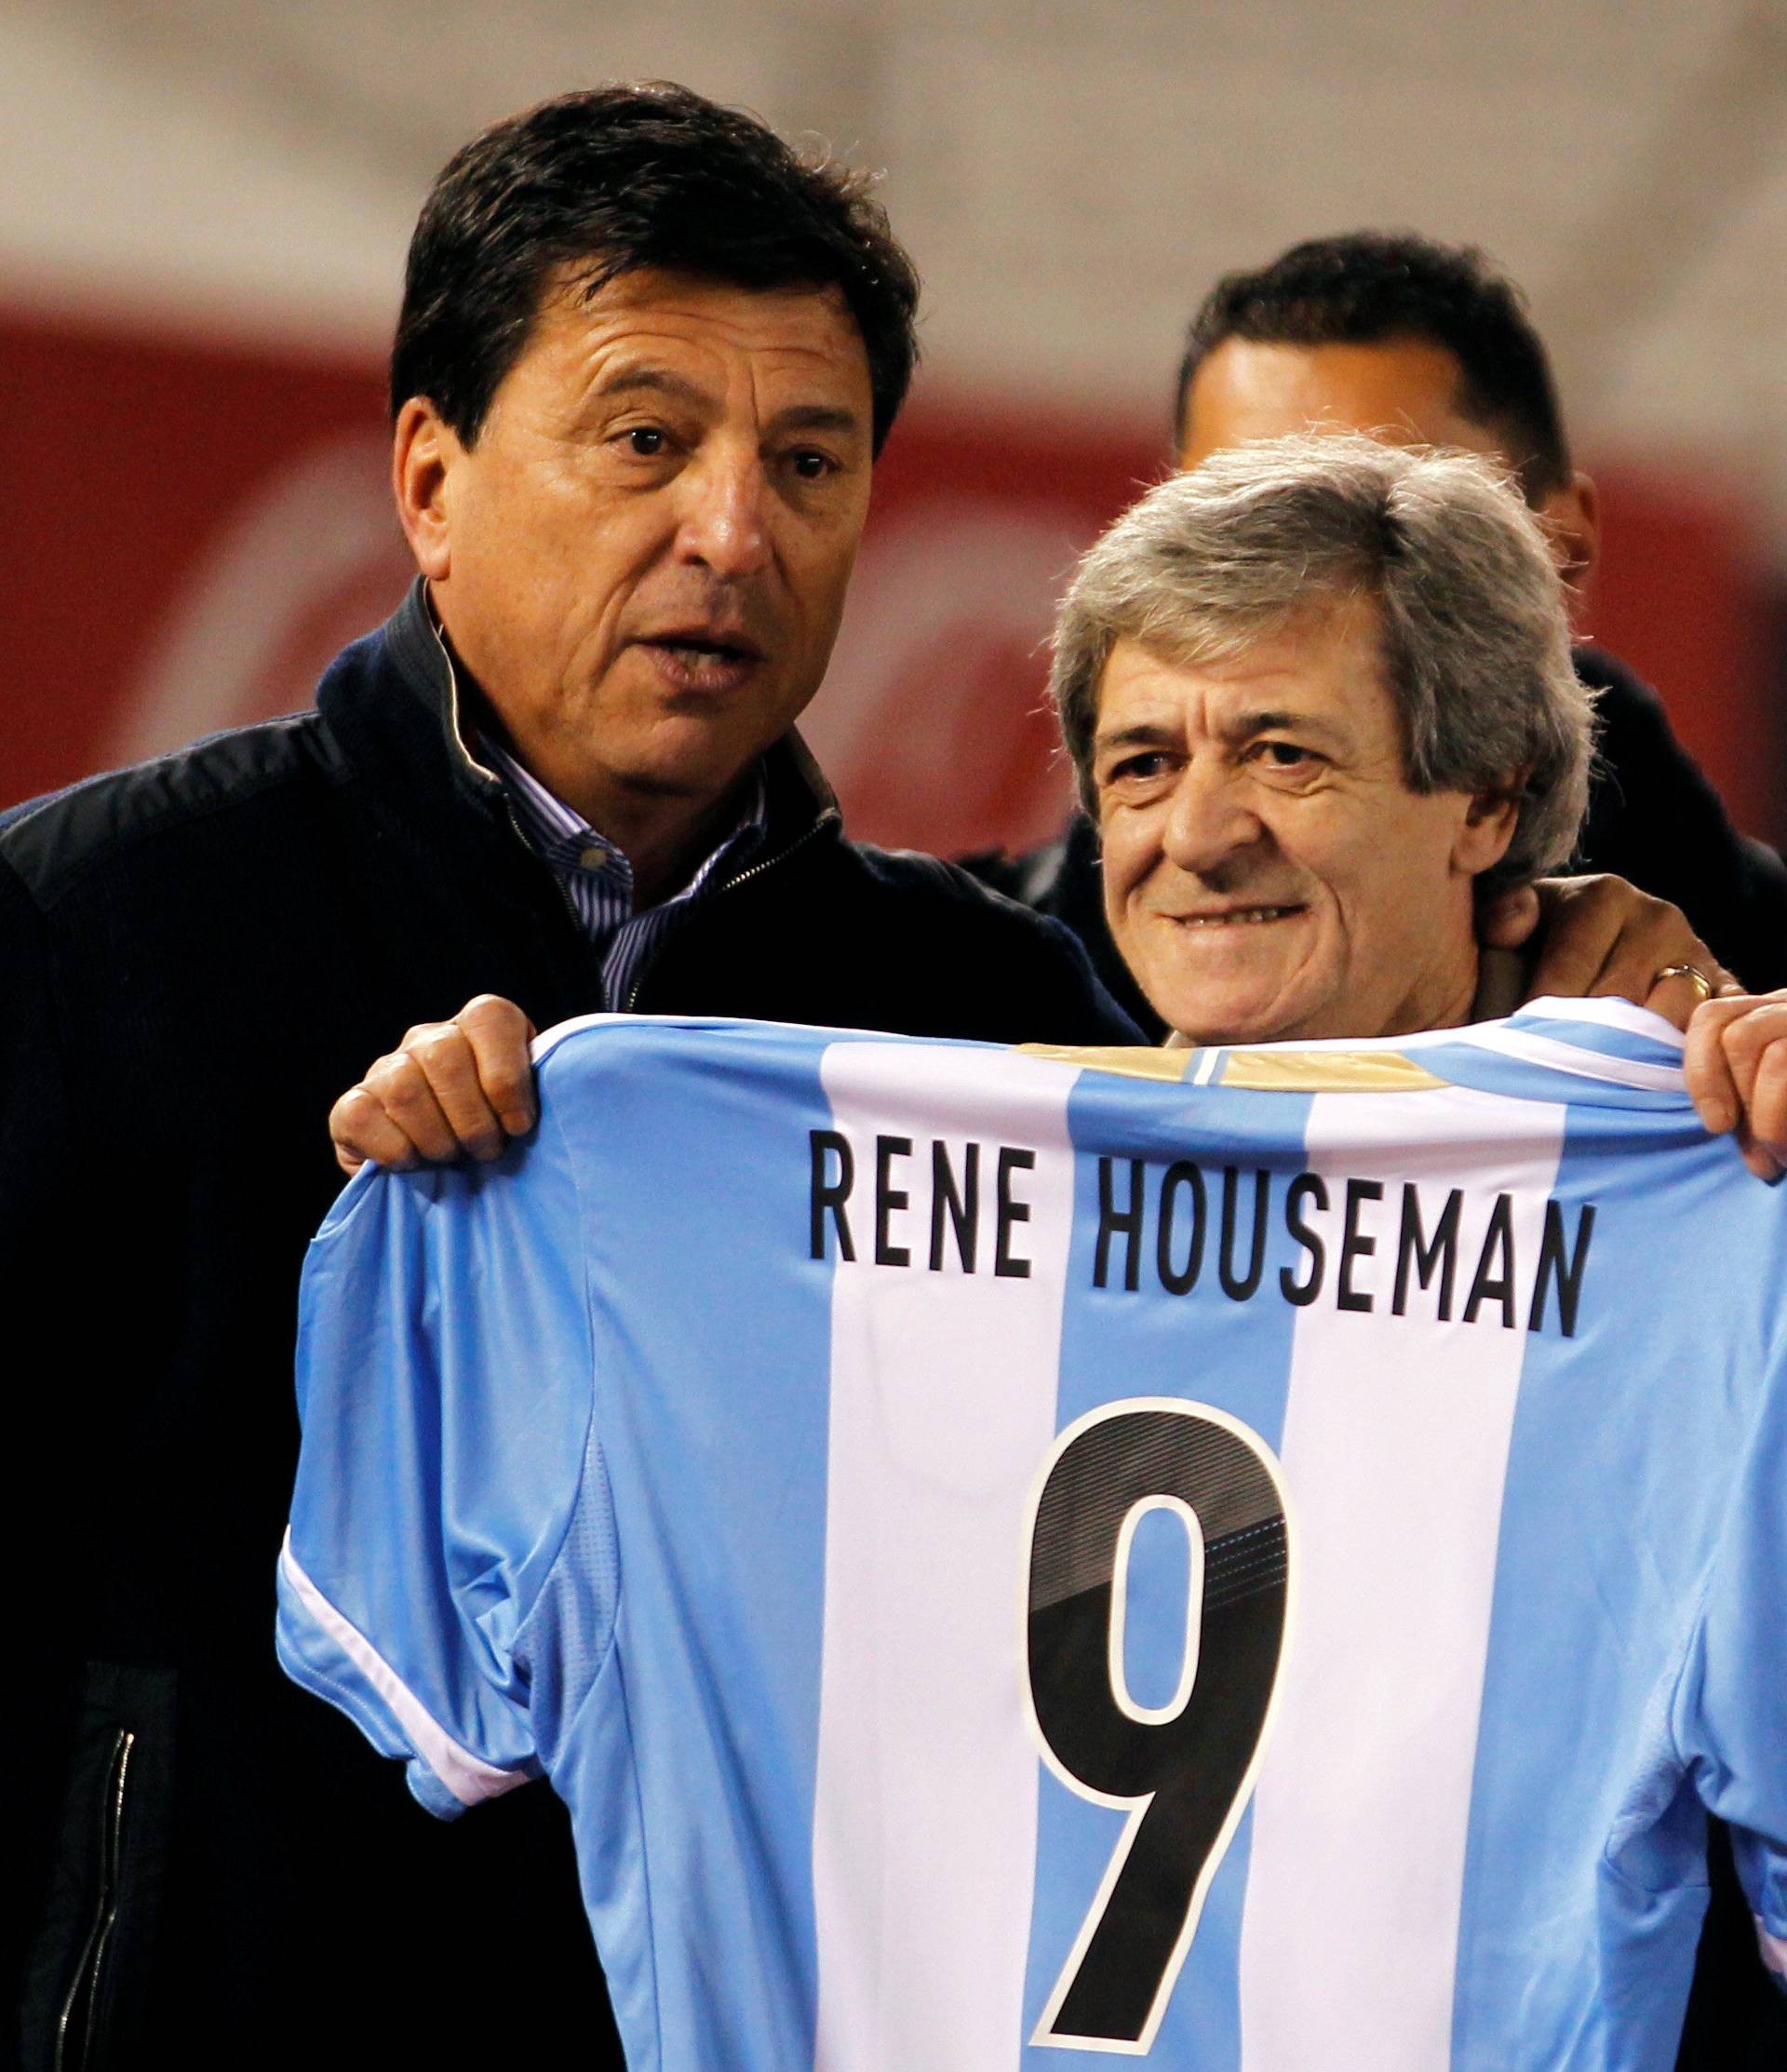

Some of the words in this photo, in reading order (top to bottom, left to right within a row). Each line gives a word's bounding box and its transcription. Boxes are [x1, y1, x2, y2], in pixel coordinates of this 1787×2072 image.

[809, 1128, 1036, 1279] RENE
[1093, 1156, 1596, 1339] HOUSEMAN
[1021, 1397, 1299, 2055] 9
